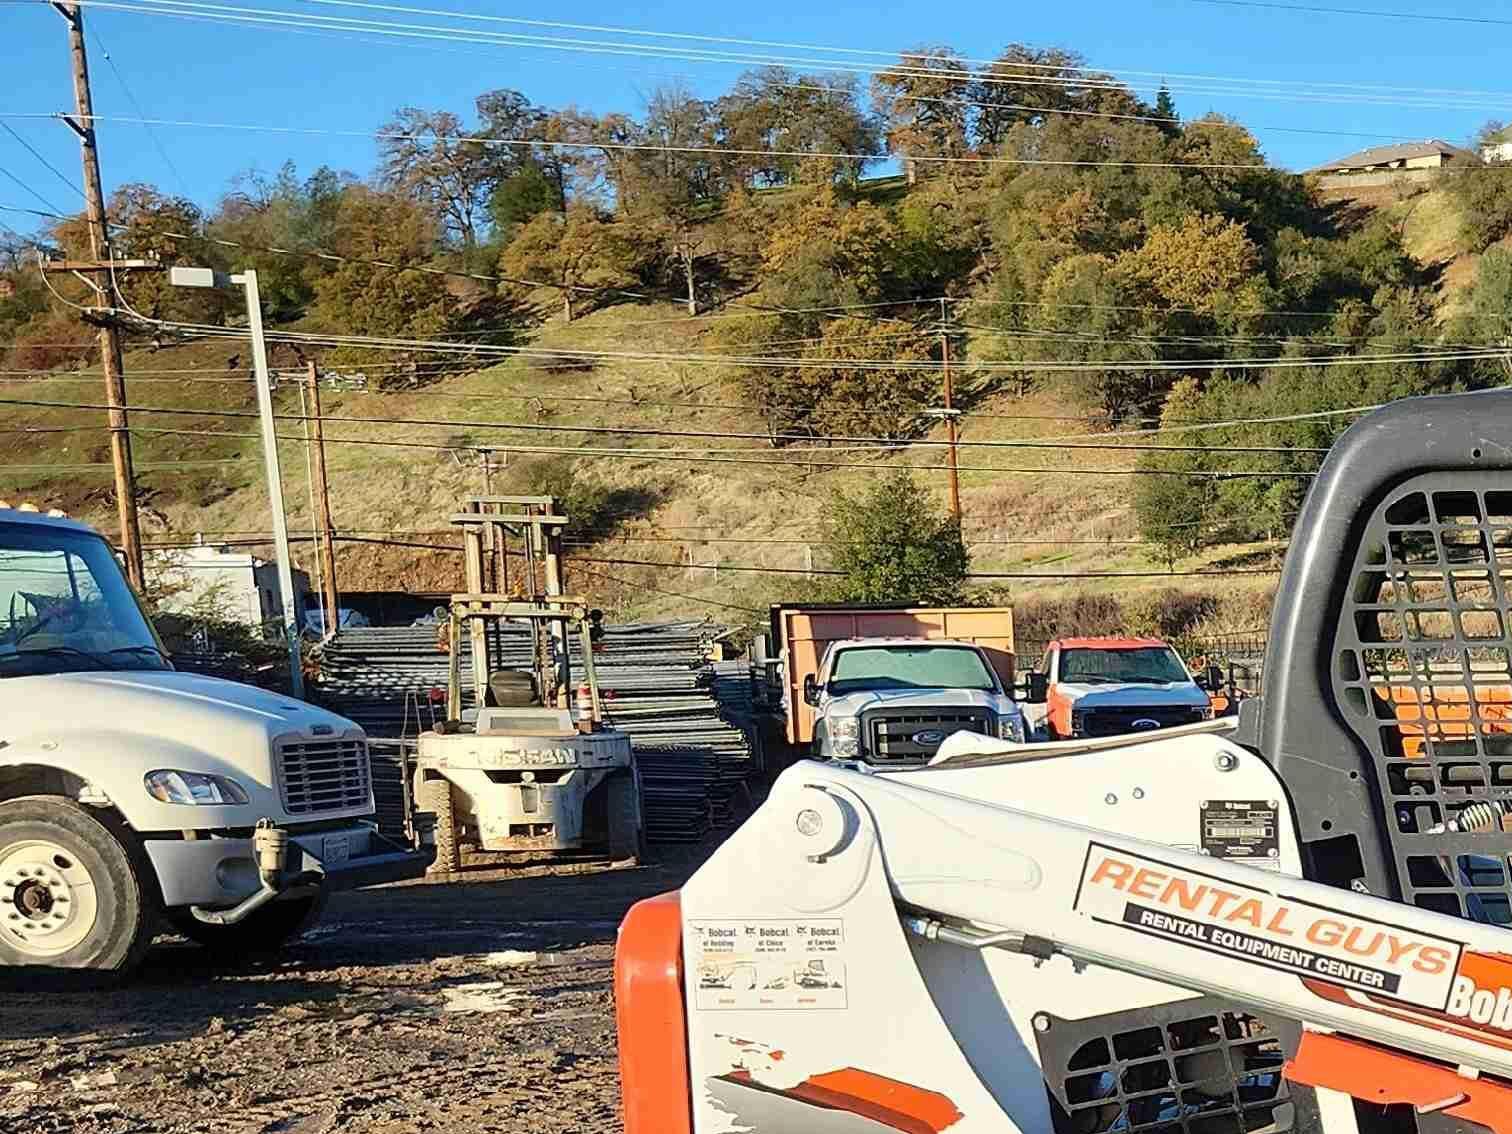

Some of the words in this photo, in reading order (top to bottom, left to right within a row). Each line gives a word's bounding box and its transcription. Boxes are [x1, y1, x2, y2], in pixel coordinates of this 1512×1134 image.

[1090, 857, 1294, 936] RENTAL
[1305, 918, 1452, 976] GUYS
[1140, 910, 1207, 940] RENTAL
[1211, 928, 1315, 968] EQUIPMENT
[1315, 957, 1385, 989] CENTER
